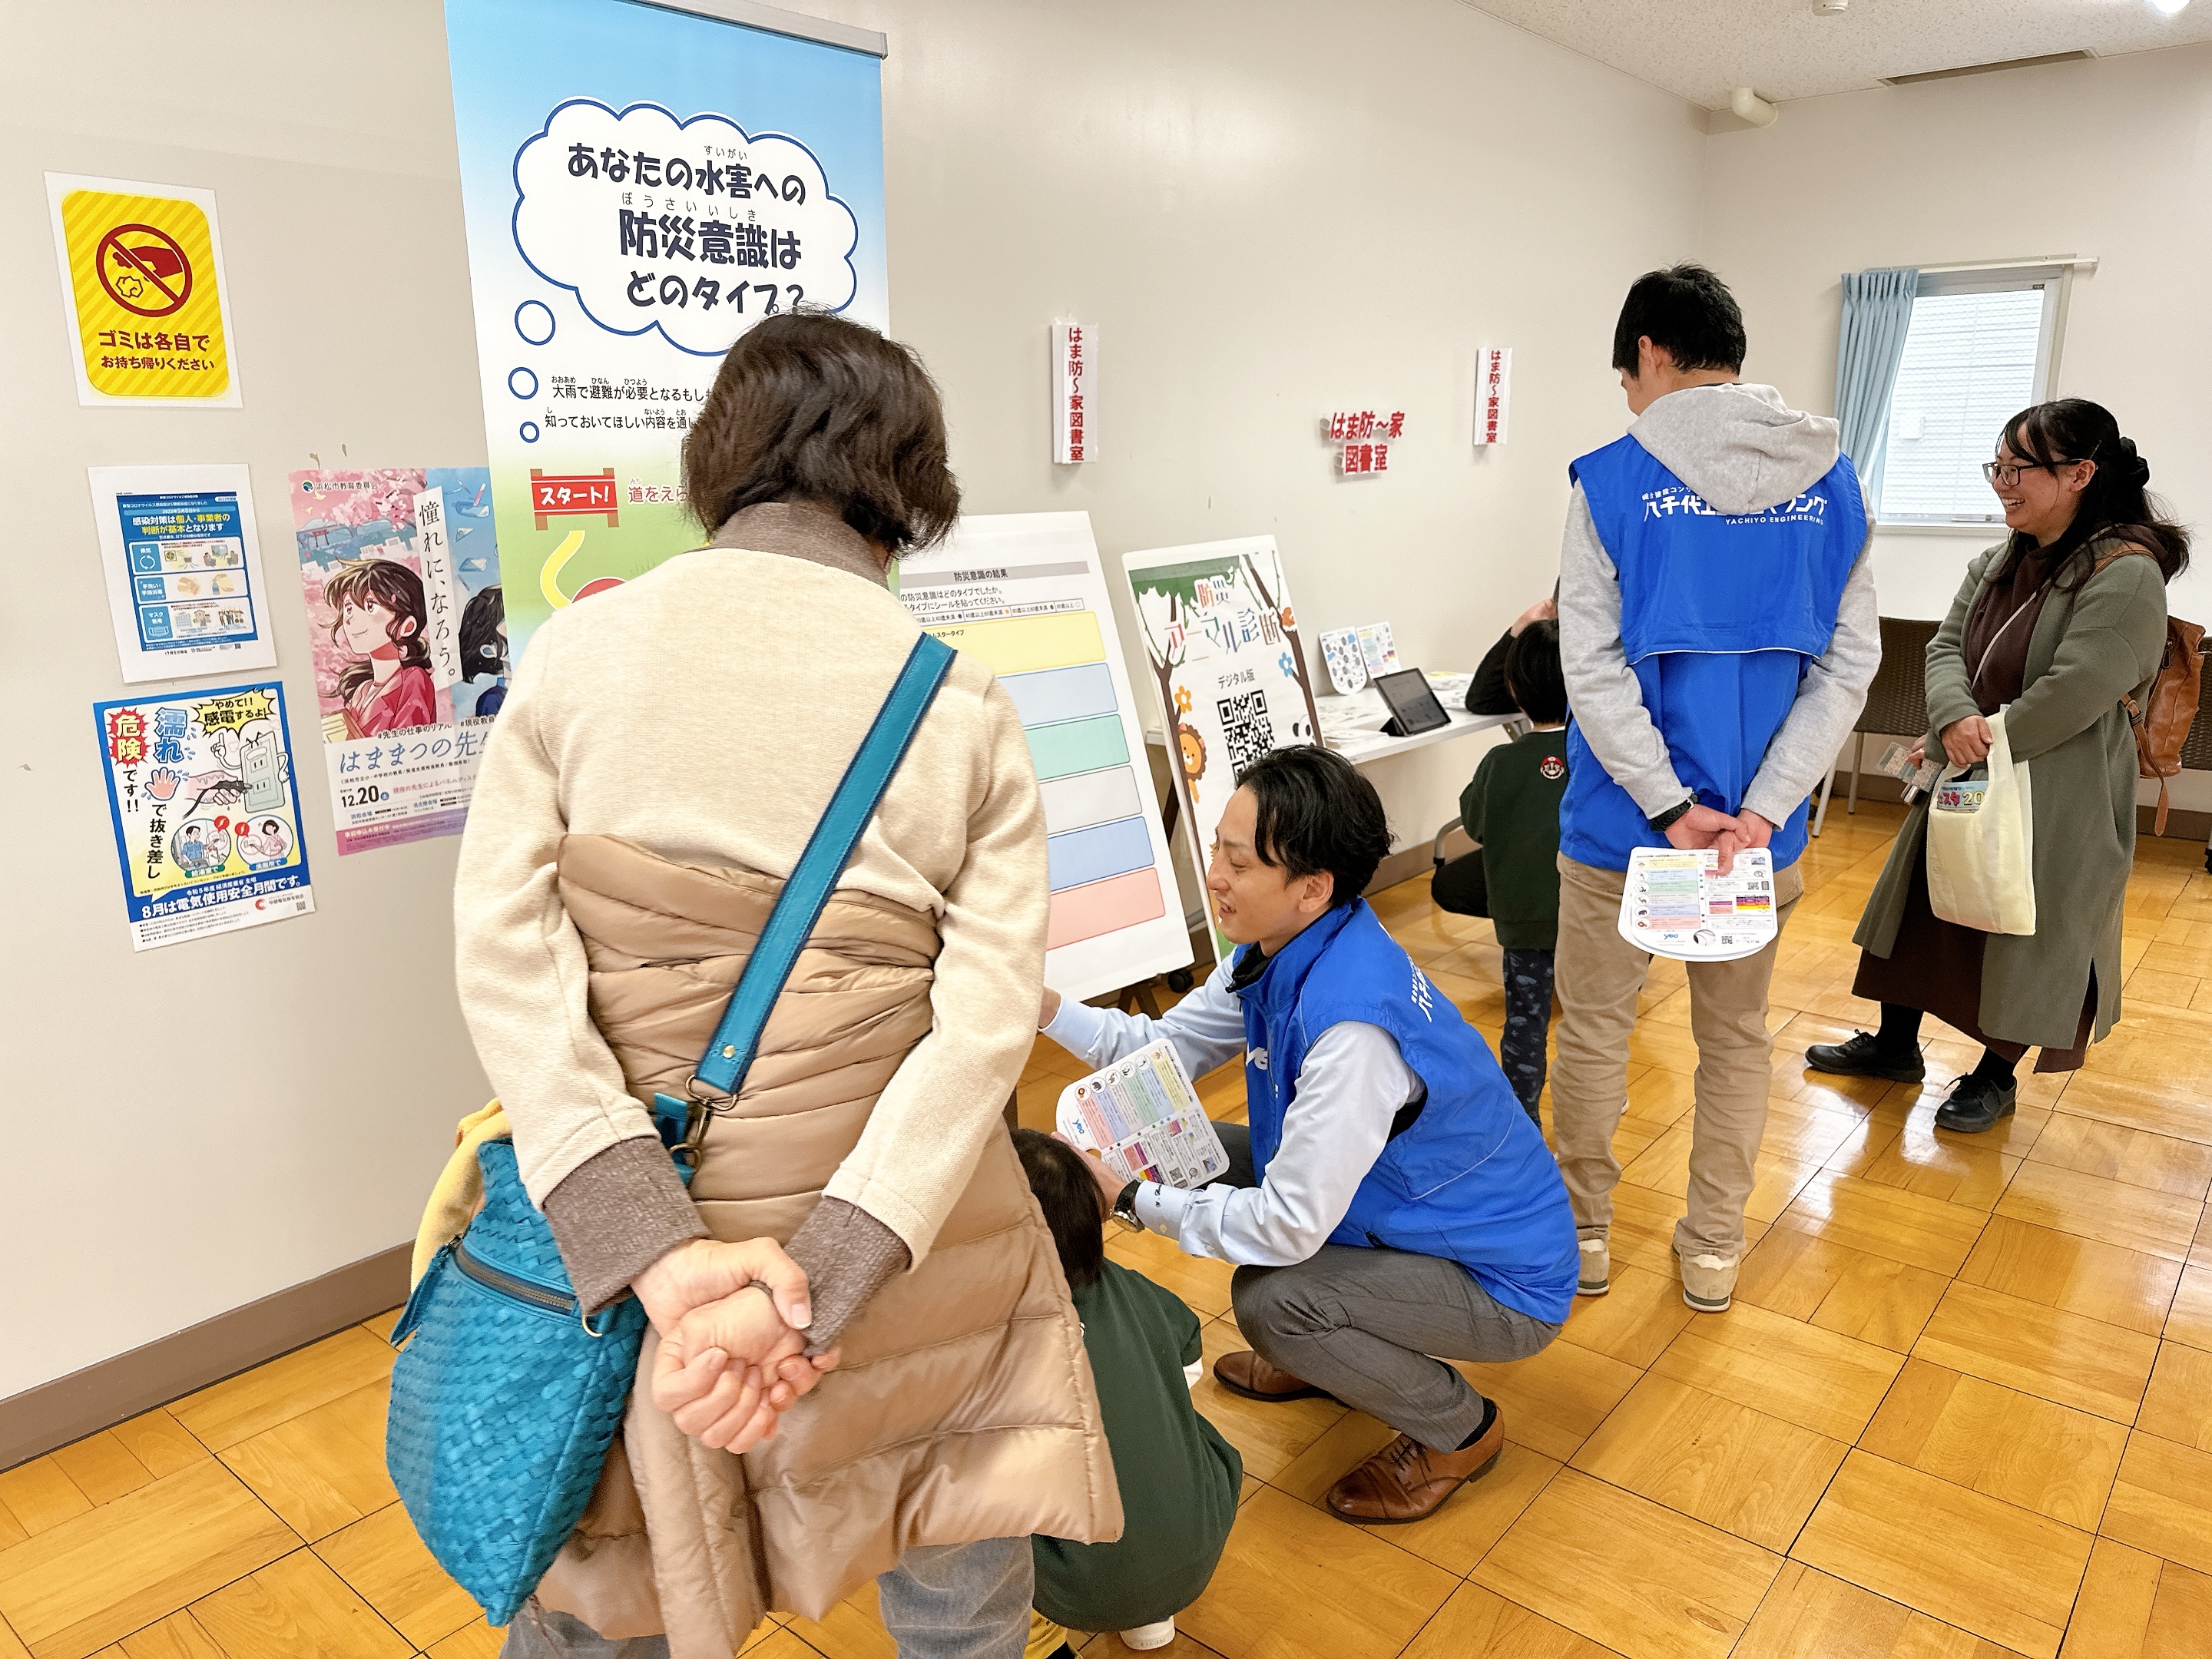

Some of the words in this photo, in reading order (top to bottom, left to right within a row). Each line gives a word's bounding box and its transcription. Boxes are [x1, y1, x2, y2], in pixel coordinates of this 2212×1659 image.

[704, 145, 747, 161] すいがい
[568, 143, 806, 205] あなたの水害への
[621, 192, 757, 222] ぼうさいいしき
[619, 209, 801, 270] 防災意識は
[98, 330, 210, 351] ゴミは各自で
[101, 356, 214, 370] お持ち帰りください
[1345, 444, 1388, 473] 図書室
[540, 485, 610, 506] スタート!
[628, 485, 688, 503] 道をえら
[1725, 517, 1766, 525] YACHIYO
[1770, 515, 1823, 525] ENGINEERING
[953, 568, 1008, 582] 防災意識の結果
[419, 501, 455, 675] 憧れに、なろう。
[900, 586, 1002, 602] の防災意識はどのタイプでしたか。
[1218, 669, 1255, 689] デジタル版
[154, 707, 189, 764] 濡れ
[377, 724, 452, 740] #先生の仕事のリアル
[341, 785, 379, 808] 12.20
[147, 804, 167, 879] で抜き差し
[142, 875, 300, 919] 8月は電気使用安全月間です。
